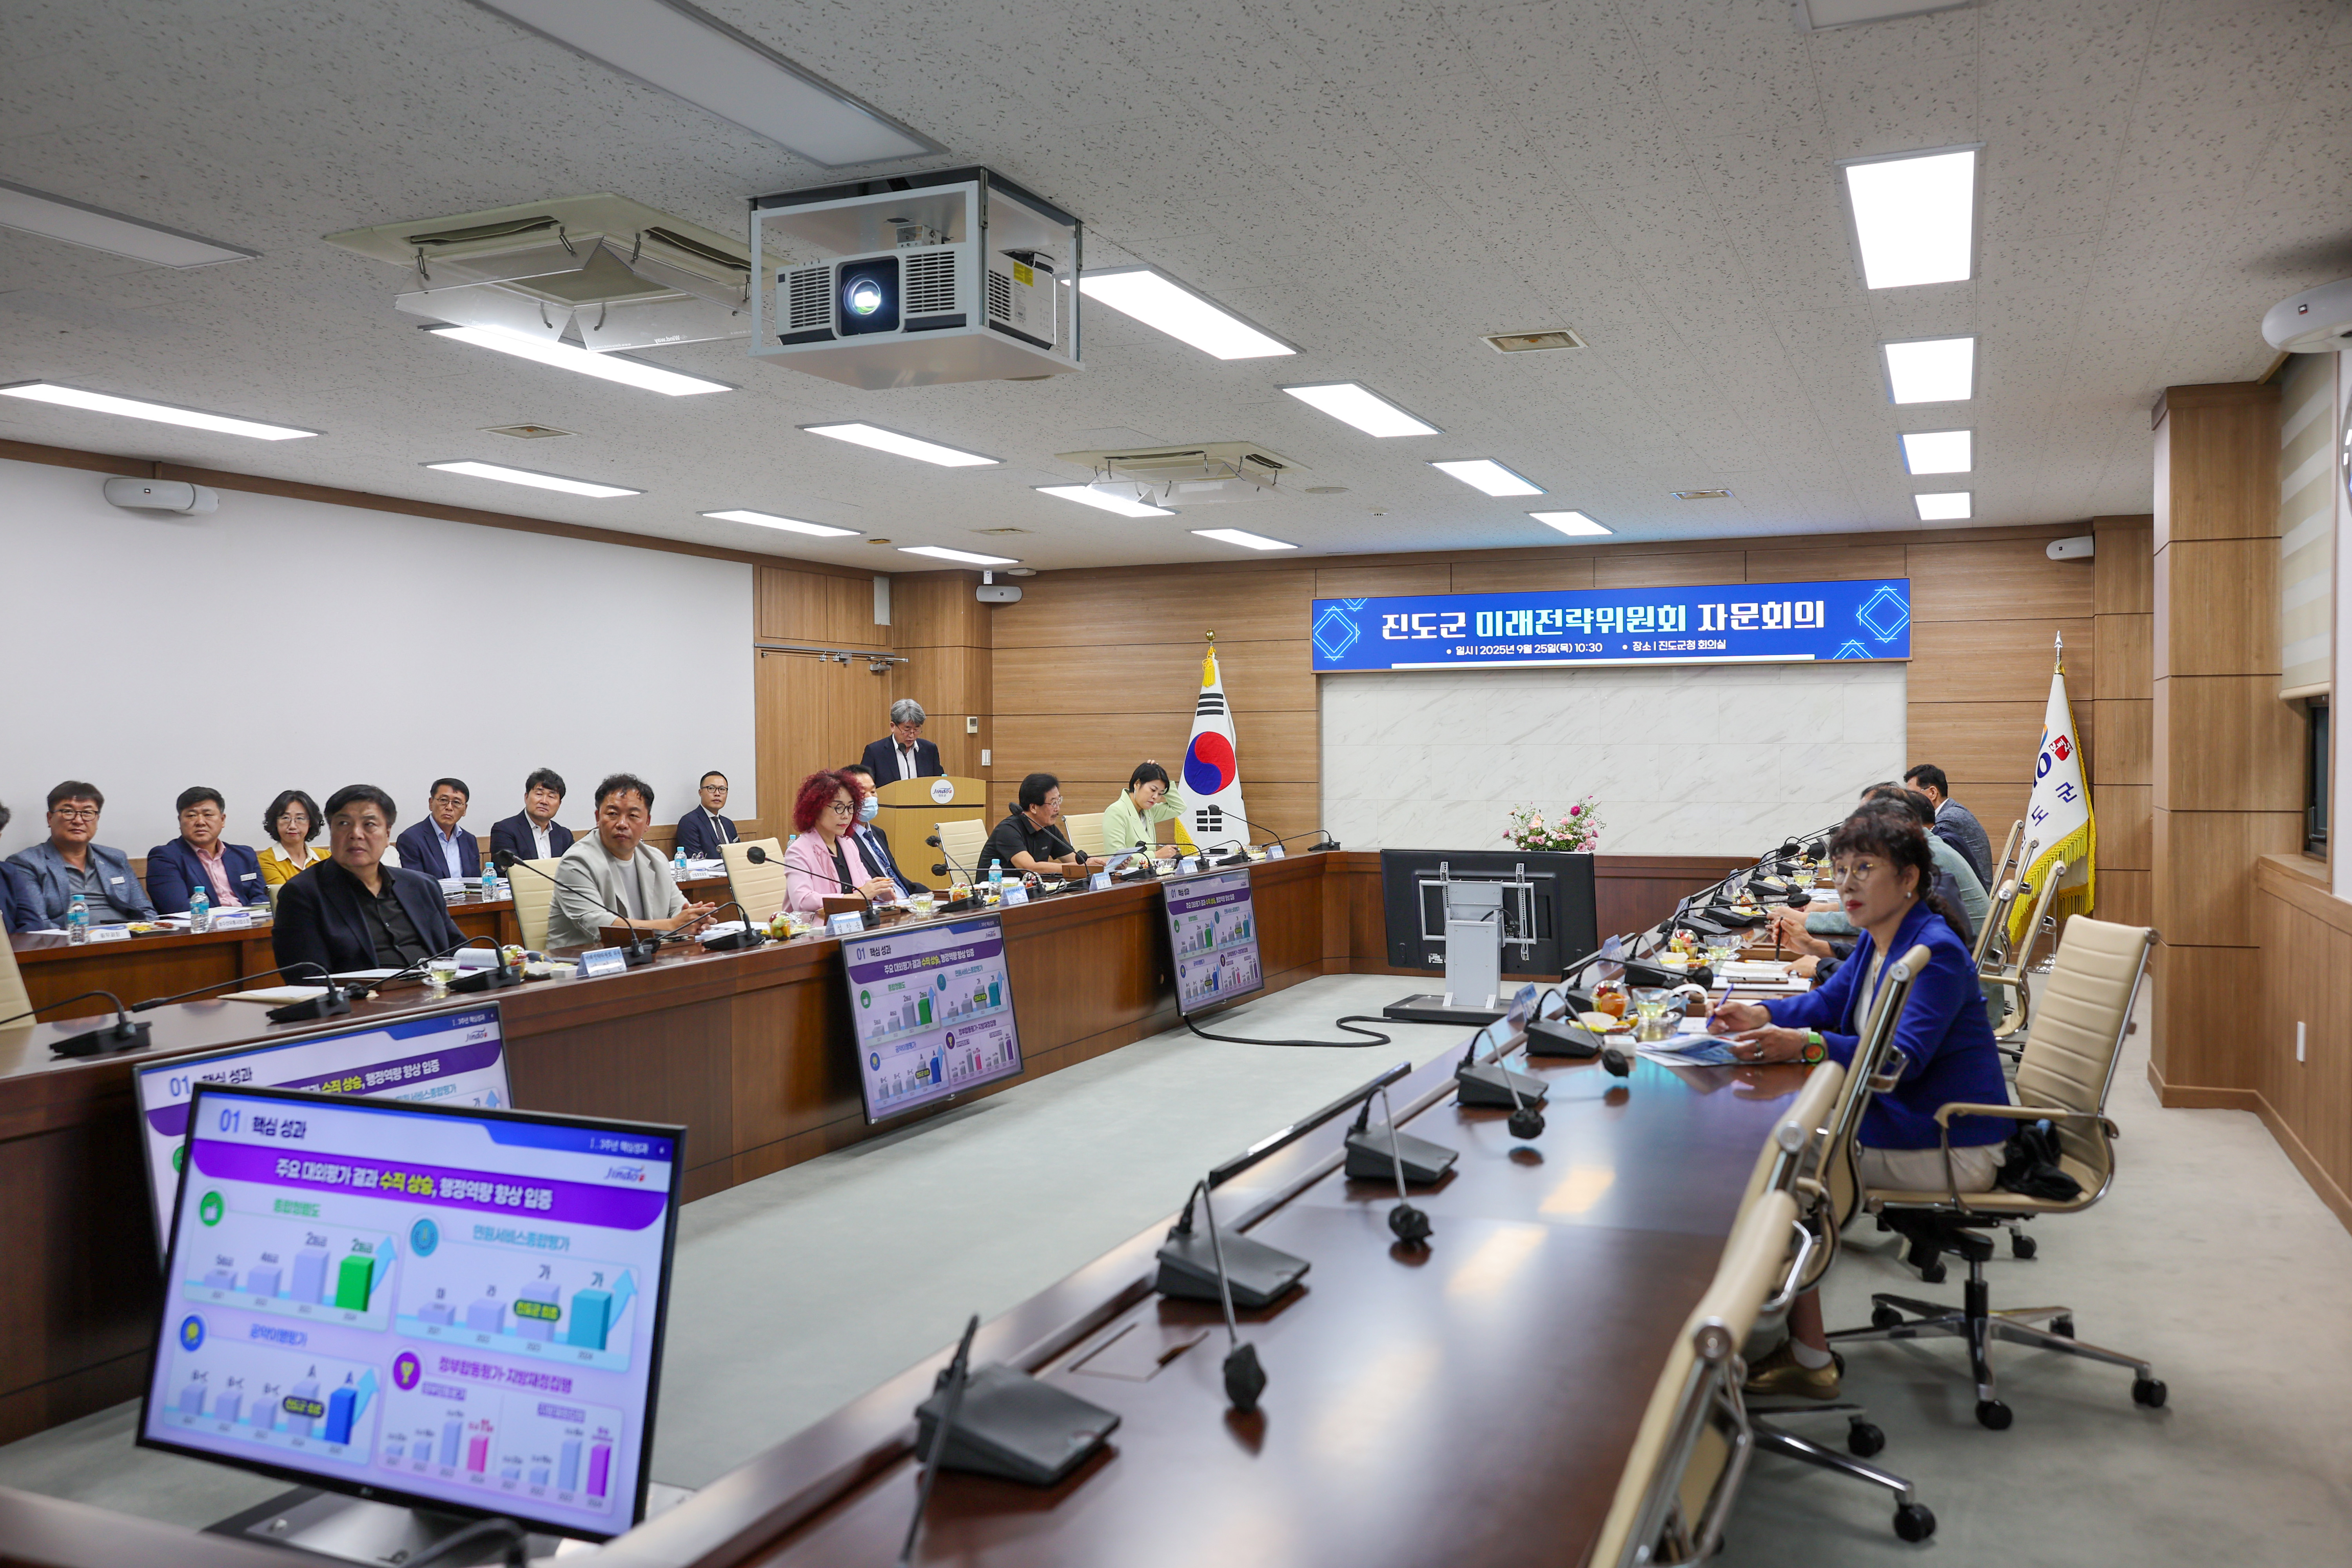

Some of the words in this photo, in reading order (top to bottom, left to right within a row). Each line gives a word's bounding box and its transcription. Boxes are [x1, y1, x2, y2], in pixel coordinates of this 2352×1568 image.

[1382, 612, 1466, 640] 진도군
[1476, 604, 1686, 637] 미래전략위원회
[1697, 600, 1824, 631] 자문회의
[1455, 646, 1474, 655] 일시
[1479, 645, 1515, 655] 2025년
[1517, 644, 1532, 654] 9월
[1534, 642, 1573, 653] 25일(목)
[1575, 642, 1603, 653] 10:30
[1632, 641, 1651, 651] 장소
[1658, 640, 1696, 651] 진도군청
[1697, 639, 1726, 650] 회의실
[1171, 889, 1176, 898] 01
[857, 947, 866, 960] 01
[870, 947, 880, 957] 핵심
[881, 945, 891, 956] 성과
[884, 964, 894, 974] 주요
[894, 961, 912, 973] 대외평가
[912, 959, 921, 968] 결과
[921, 957, 930, 967] 수직
[940, 952, 957, 963] 행정역량
[957, 949, 966, 960] 향상
[966, 948, 975, 958] 입증
[465, 1030, 485, 1042] Jindo
[170, 1075, 191, 1097] 01
[229, 1067, 252, 1083] 성과
[321, 1079, 341, 1093] 수직
[365, 1067, 402, 1087] 행정역량
[402, 1062, 421, 1078] 향상
[421, 1059, 440, 1075] 입증
[220, 1108, 241, 1133] 01
[252, 1116, 276, 1137] 핵심
[280, 1120, 307, 1139] 성과
[604, 1166, 640, 1183] Jindo
[276, 1158, 301, 1178] 주요
[302, 1161, 351, 1186] 대외평가
[352, 1167, 379, 1189] 결과
[379, 1171, 407, 1192] 수직
[439, 1176, 494, 1203] 행정역량
[494, 1183, 524, 1207] 향상
[523, 1187, 553, 1211] 입증
[538, 1265, 551, 1279] 가
[592, 1272, 604, 1287] 가
